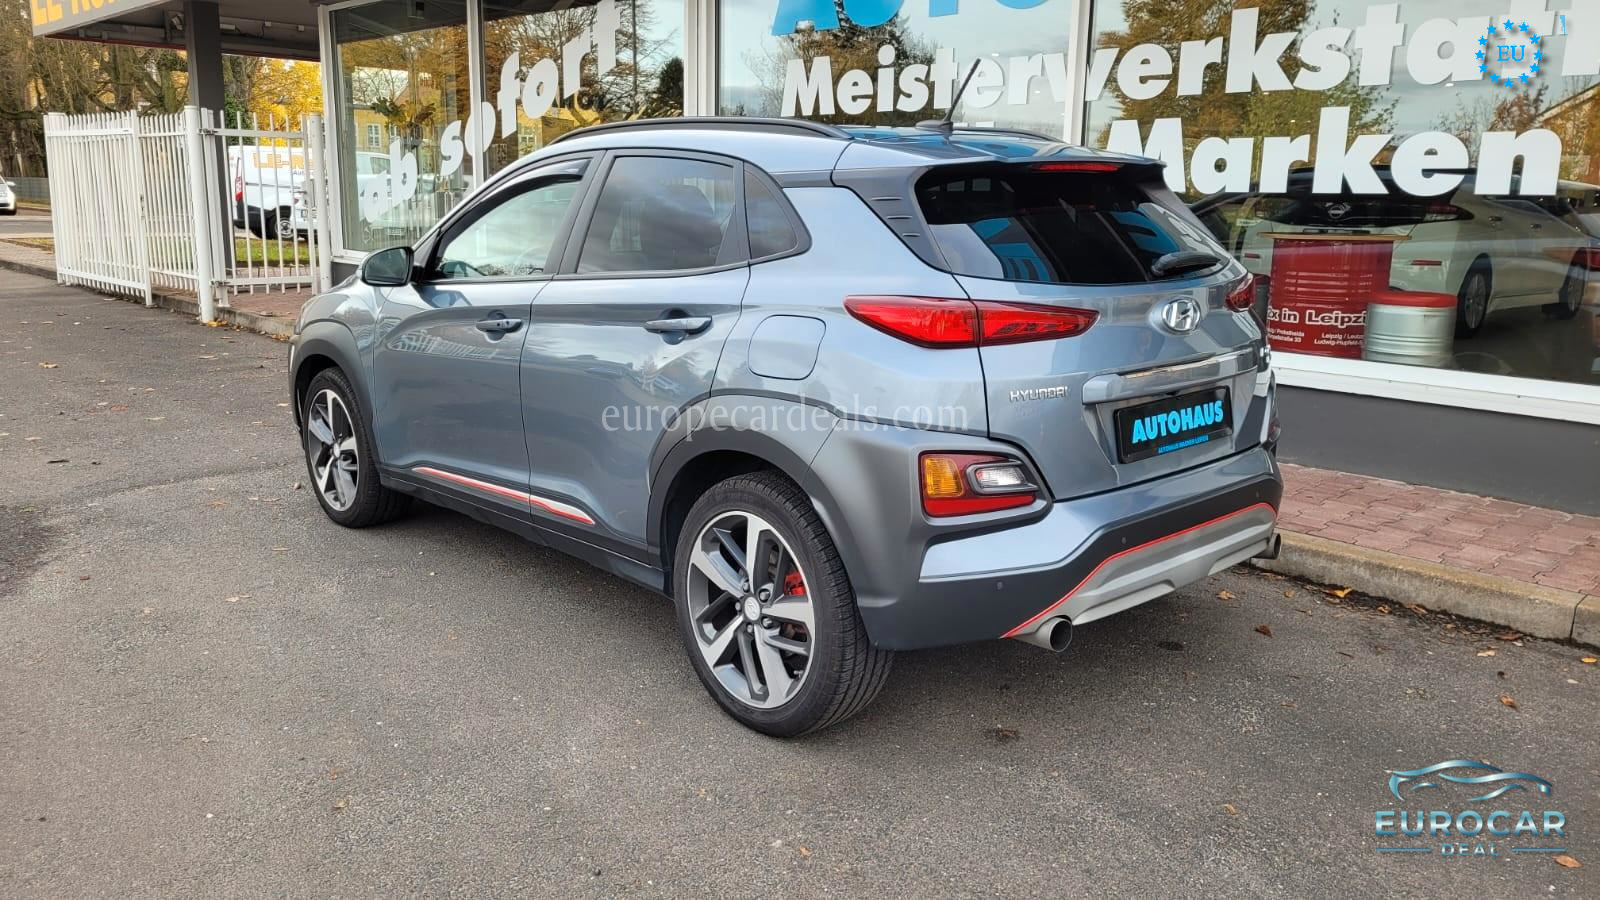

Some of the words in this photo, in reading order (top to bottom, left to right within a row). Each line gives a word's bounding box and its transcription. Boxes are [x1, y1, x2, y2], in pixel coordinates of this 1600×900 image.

[440, 0, 621, 176] sofort
[1106, 105, 1562, 197] Marken
[1281, 307, 1299, 323] in
[1305, 309, 1367, 328] Leipzi
[1009, 385, 1068, 401] HYUNDAI
[1131, 399, 1224, 445] AUTOHAUS
